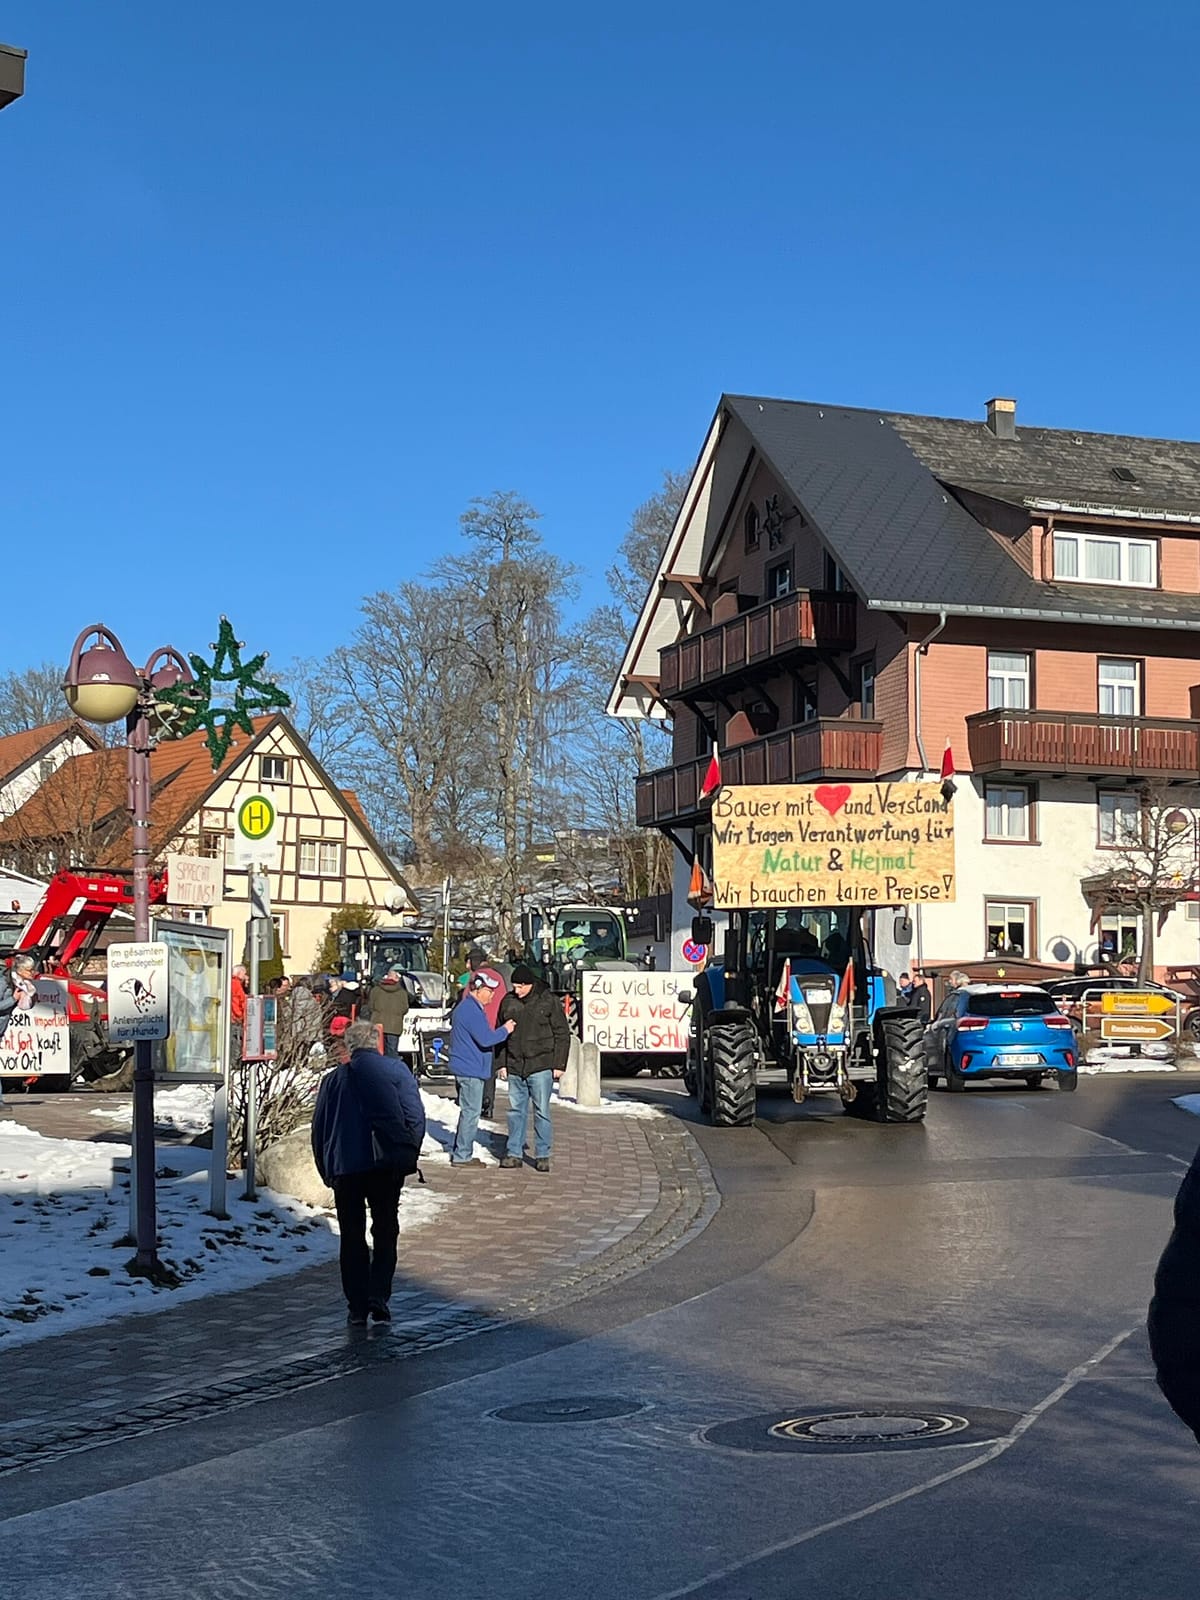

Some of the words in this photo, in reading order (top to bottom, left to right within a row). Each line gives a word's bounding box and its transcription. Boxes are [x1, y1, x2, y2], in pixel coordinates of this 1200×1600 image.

[715, 789, 780, 817] Bauer
[786, 792, 815, 816] mit
[844, 793, 875, 815] und
[875, 784, 949, 814] Verstand
[249, 804, 264, 831] H
[713, 820, 743, 845] Wir
[746, 820, 794, 846] tragen
[798, 820, 920, 844] Verantwortung
[926, 818, 954, 842] für
[762, 847, 823, 873] Natur
[827, 848, 844, 871] &
[850, 846, 917, 875] Heimat
[176, 862, 210, 882] SPRECHT
[714, 881, 742, 904] Wir
[750, 881, 826, 904] brauchen
[836, 878, 878, 902] faire
[885, 874, 954, 901] Preise!
[124, 946, 164, 958] gesamten
[111, 958, 164, 969] Gemeindegebiet
[588, 974, 612, 995] Zu
[622, 978, 655, 996] viel
[662, 978, 680, 996] ist
[9, 1013, 31, 1027] ssen
[113, 1014, 163, 1027] Anleinpflicht
[618, 1001, 640, 1018] Zu
[648, 1002, 680, 1020] viel
[117, 1028, 129, 1037] für
[131, 1026, 159, 1037] Hunde
[587, 1024, 632, 1050] Jetzt
[632, 1026, 650, 1050] ist
[649, 1024, 688, 1050] Schlu
[16, 1031, 34, 1055] fort
[37, 1032, 62, 1056] kauft
[21, 1052, 43, 1072] Ort!
